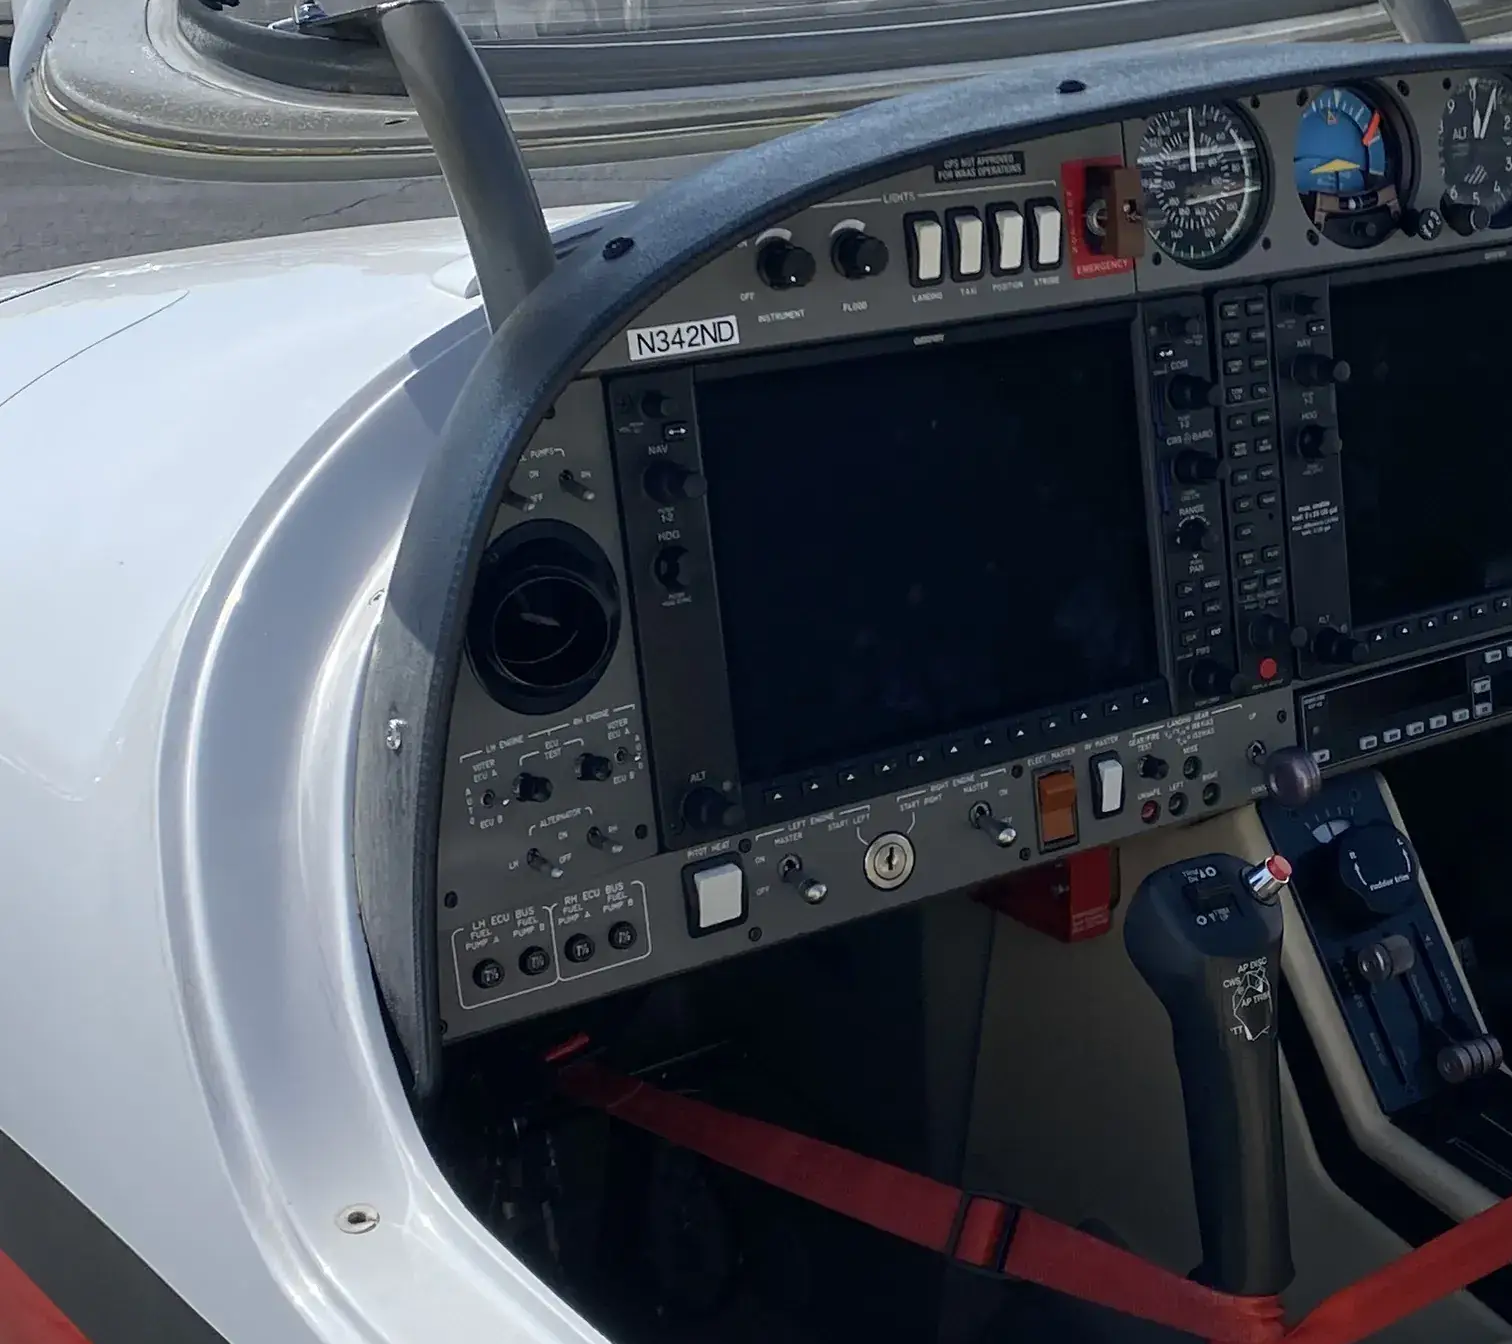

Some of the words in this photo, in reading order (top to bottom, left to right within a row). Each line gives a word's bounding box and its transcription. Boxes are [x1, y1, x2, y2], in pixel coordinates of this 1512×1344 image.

[1447, 98, 1456, 114] 9
[1504, 114, 1511, 130] 2
[1452, 126, 1468, 140] ALT
[944, 158, 960, 170] GPS
[960, 156, 975, 168] NOT
[976, 154, 1014, 166] APPROVED
[1505, 156, 1512, 172] 3
[938, 170, 952, 181] FOR
[978, 164, 1022, 178] OPERATIONS
[1450, 184, 1458, 201] 6
[1494, 180, 1500, 192] 4
[883, 192, 916, 204] LIGHTS
[1472, 191, 1480, 206] 5
[1076, 258, 1128, 274] EMERGENCY
[992, 279, 1024, 292] POSITION
[1033, 276, 1060, 286] STROBE
[740, 292, 754, 302] OFF
[912, 292, 944, 303] LANDING
[960, 286, 978, 296] TAXI
[842, 300, 868, 312] FLOOD
[758, 309, 806, 323] INSTRUMENT
[636, 320, 735, 356] N342ND
[648, 444, 668, 456] NAV
[657, 530, 680, 542] HDG
[585, 708, 610, 723] ENGINE
[606, 718, 629, 730] VOTER
[1166, 716, 1192, 729] LANDING
[607, 730, 621, 741] ECU
[1095, 735, 1120, 748] MASTER
[485, 742, 497, 754] LH
[499, 735, 524, 749] ENGINE
[544, 739, 559, 750] ECU
[1137, 742, 1153, 754] TEST
[544, 747, 562, 760] TEST
[1050, 746, 1076, 761] MASTER
[472, 758, 496, 772] VOTER
[473, 773, 489, 783] ECU
[613, 774, 627, 785] ECU
[689, 770, 707, 783] ALT
[930, 780, 949, 793] RIGHT
[952, 774, 976, 788] ENGINE
[963, 781, 989, 794] MASTER
[1168, 781, 1184, 792] LEFT
[998, 788, 1008, 797] ON
[900, 799, 921, 812] START
[924, 794, 943, 807] RIGHT
[480, 818, 495, 829] ECU
[540, 808, 582, 828] ALTERNATOR
[787, 818, 807, 832] LEFT
[810, 812, 835, 826] ENGINE
[828, 818, 849, 832] START
[852, 813, 871, 826] LEFT
[558, 830, 568, 840] ON
[774, 832, 804, 846] MASTER
[686, 847, 708, 860] PITOT
[710, 840, 731, 854] HEAT
[558, 852, 572, 865] OFF
[754, 856, 766, 864] ON
[1369, 878, 1394, 892] rudder
[1394, 874, 1410, 884] trim
[564, 895, 578, 906] RH
[582, 889, 600, 902] ECU
[605, 882, 624, 895] BUS
[756, 885, 770, 897] OFF
[607, 892, 628, 904] FUEL
[562, 904, 584, 916] FUEL
[602, 901, 624, 914] PUMP
[472, 918, 487, 930] LH
[490, 913, 510, 926] ECU
[514, 906, 535, 919] BUS
[516, 916, 539, 928] FUEL
[558, 914, 581, 926] PUMP
[470, 928, 493, 940] FUEL
[512, 926, 536, 939] PUMP
[465, 939, 488, 952] PUMP
[1237, 962, 1250, 974] AP
[1250, 956, 1268, 969] DISC
[1222, 976, 1242, 989] CWS
[1241, 996, 1253, 1008] AP
